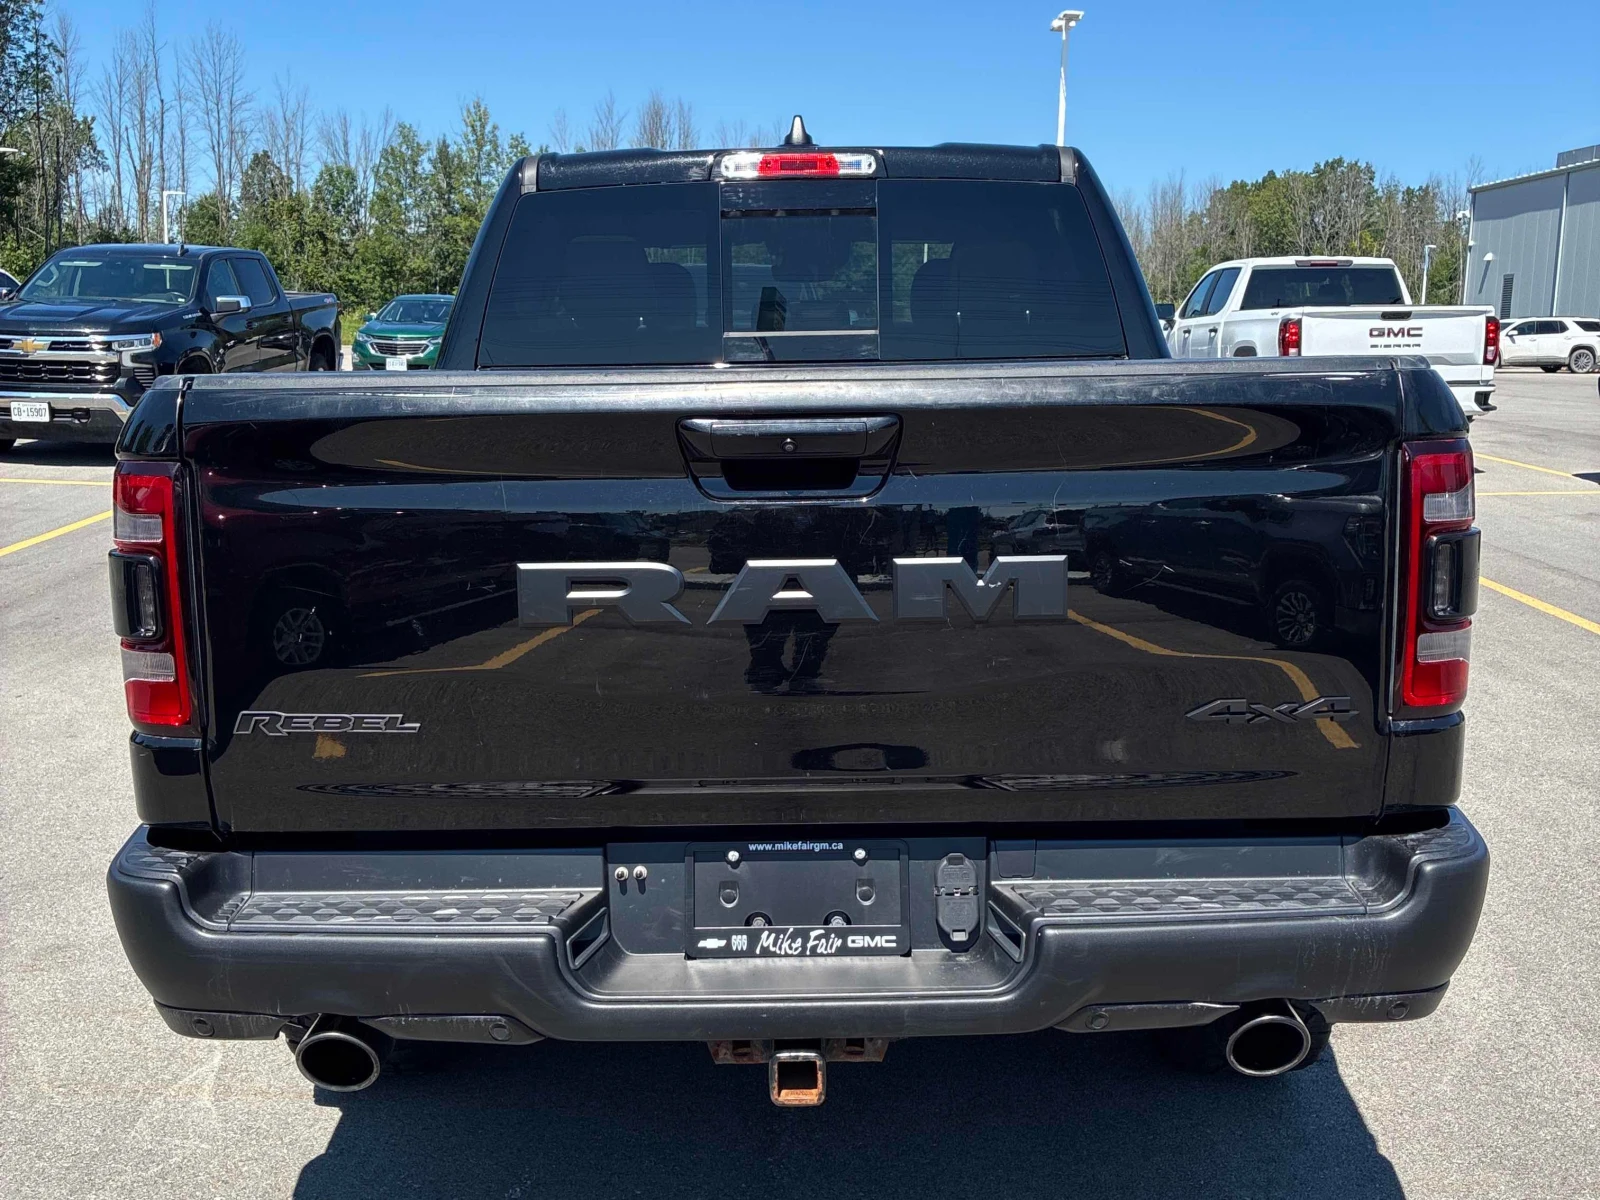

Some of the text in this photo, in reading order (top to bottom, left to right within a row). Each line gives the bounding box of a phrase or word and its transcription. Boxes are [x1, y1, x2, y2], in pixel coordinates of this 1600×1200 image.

[1369, 327, 1423, 338] GMC
[517, 555, 1068, 626] RAM
[233, 710, 421, 736] REBEL
[748, 841, 843, 852] www.mikefairgm.ca
[755, 927, 897, 955] Mike Fair GMC
